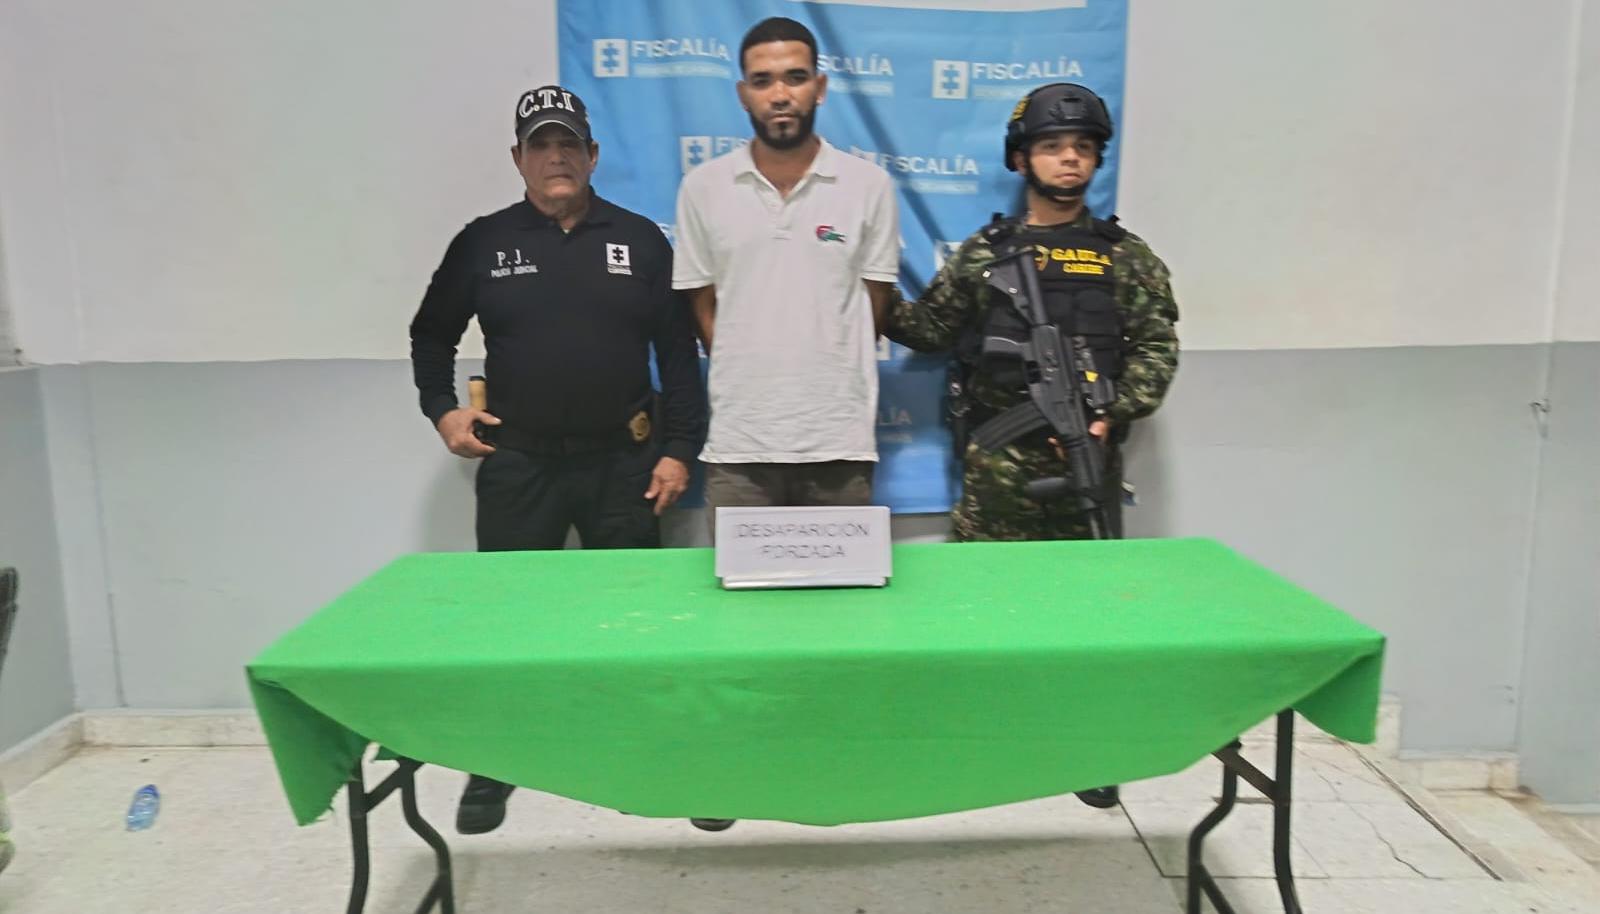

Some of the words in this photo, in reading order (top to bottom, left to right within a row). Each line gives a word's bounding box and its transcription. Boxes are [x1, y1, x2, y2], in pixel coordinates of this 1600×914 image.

[631, 38, 730, 62] FISCALÍA
[817, 53, 894, 76] SCALÍA
[972, 56, 1083, 80] FISCALÍA
